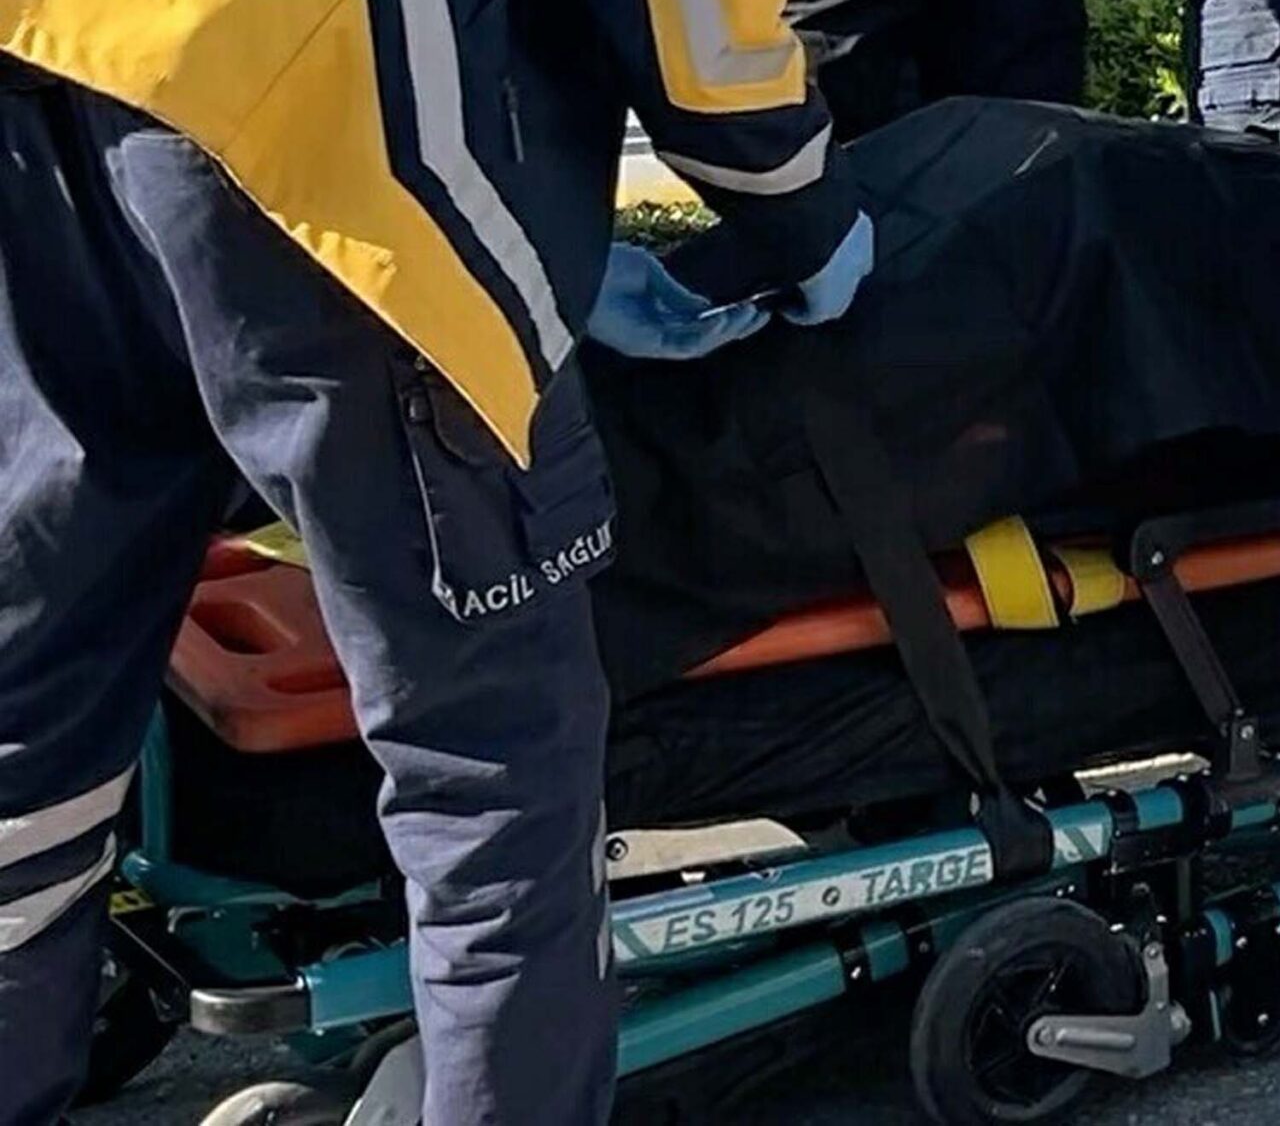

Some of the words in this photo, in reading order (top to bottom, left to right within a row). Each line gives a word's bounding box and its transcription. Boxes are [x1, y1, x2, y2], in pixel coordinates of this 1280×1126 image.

[464, 574, 535, 617] ACİL
[663, 914, 716, 952] ES
[731, 891, 796, 935] 125
